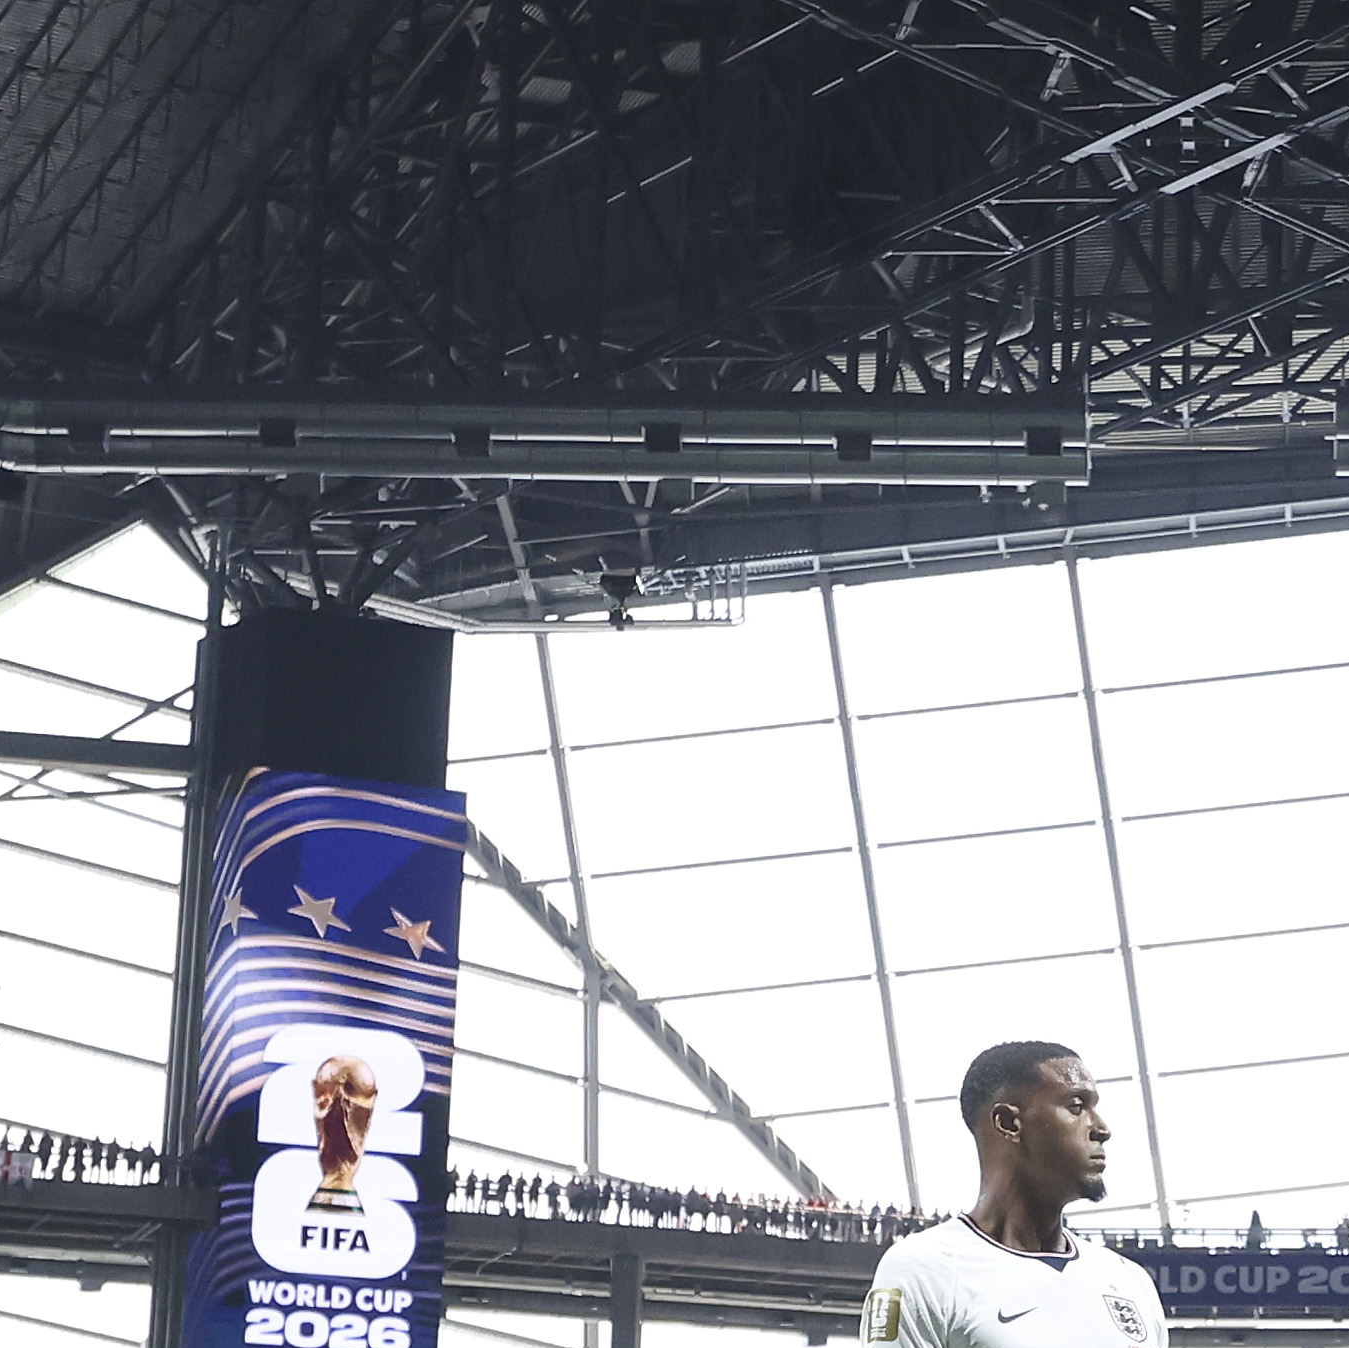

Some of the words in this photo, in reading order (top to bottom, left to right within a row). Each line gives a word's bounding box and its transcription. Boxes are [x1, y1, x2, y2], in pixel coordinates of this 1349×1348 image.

[300, 1224, 371, 1254] FIFA
[1151, 1265, 1207, 1295] LD
[1213, 1265, 1291, 1294] CUP
[248, 1281, 351, 1310] WORLD
[356, 1287, 413, 1313] CUP
